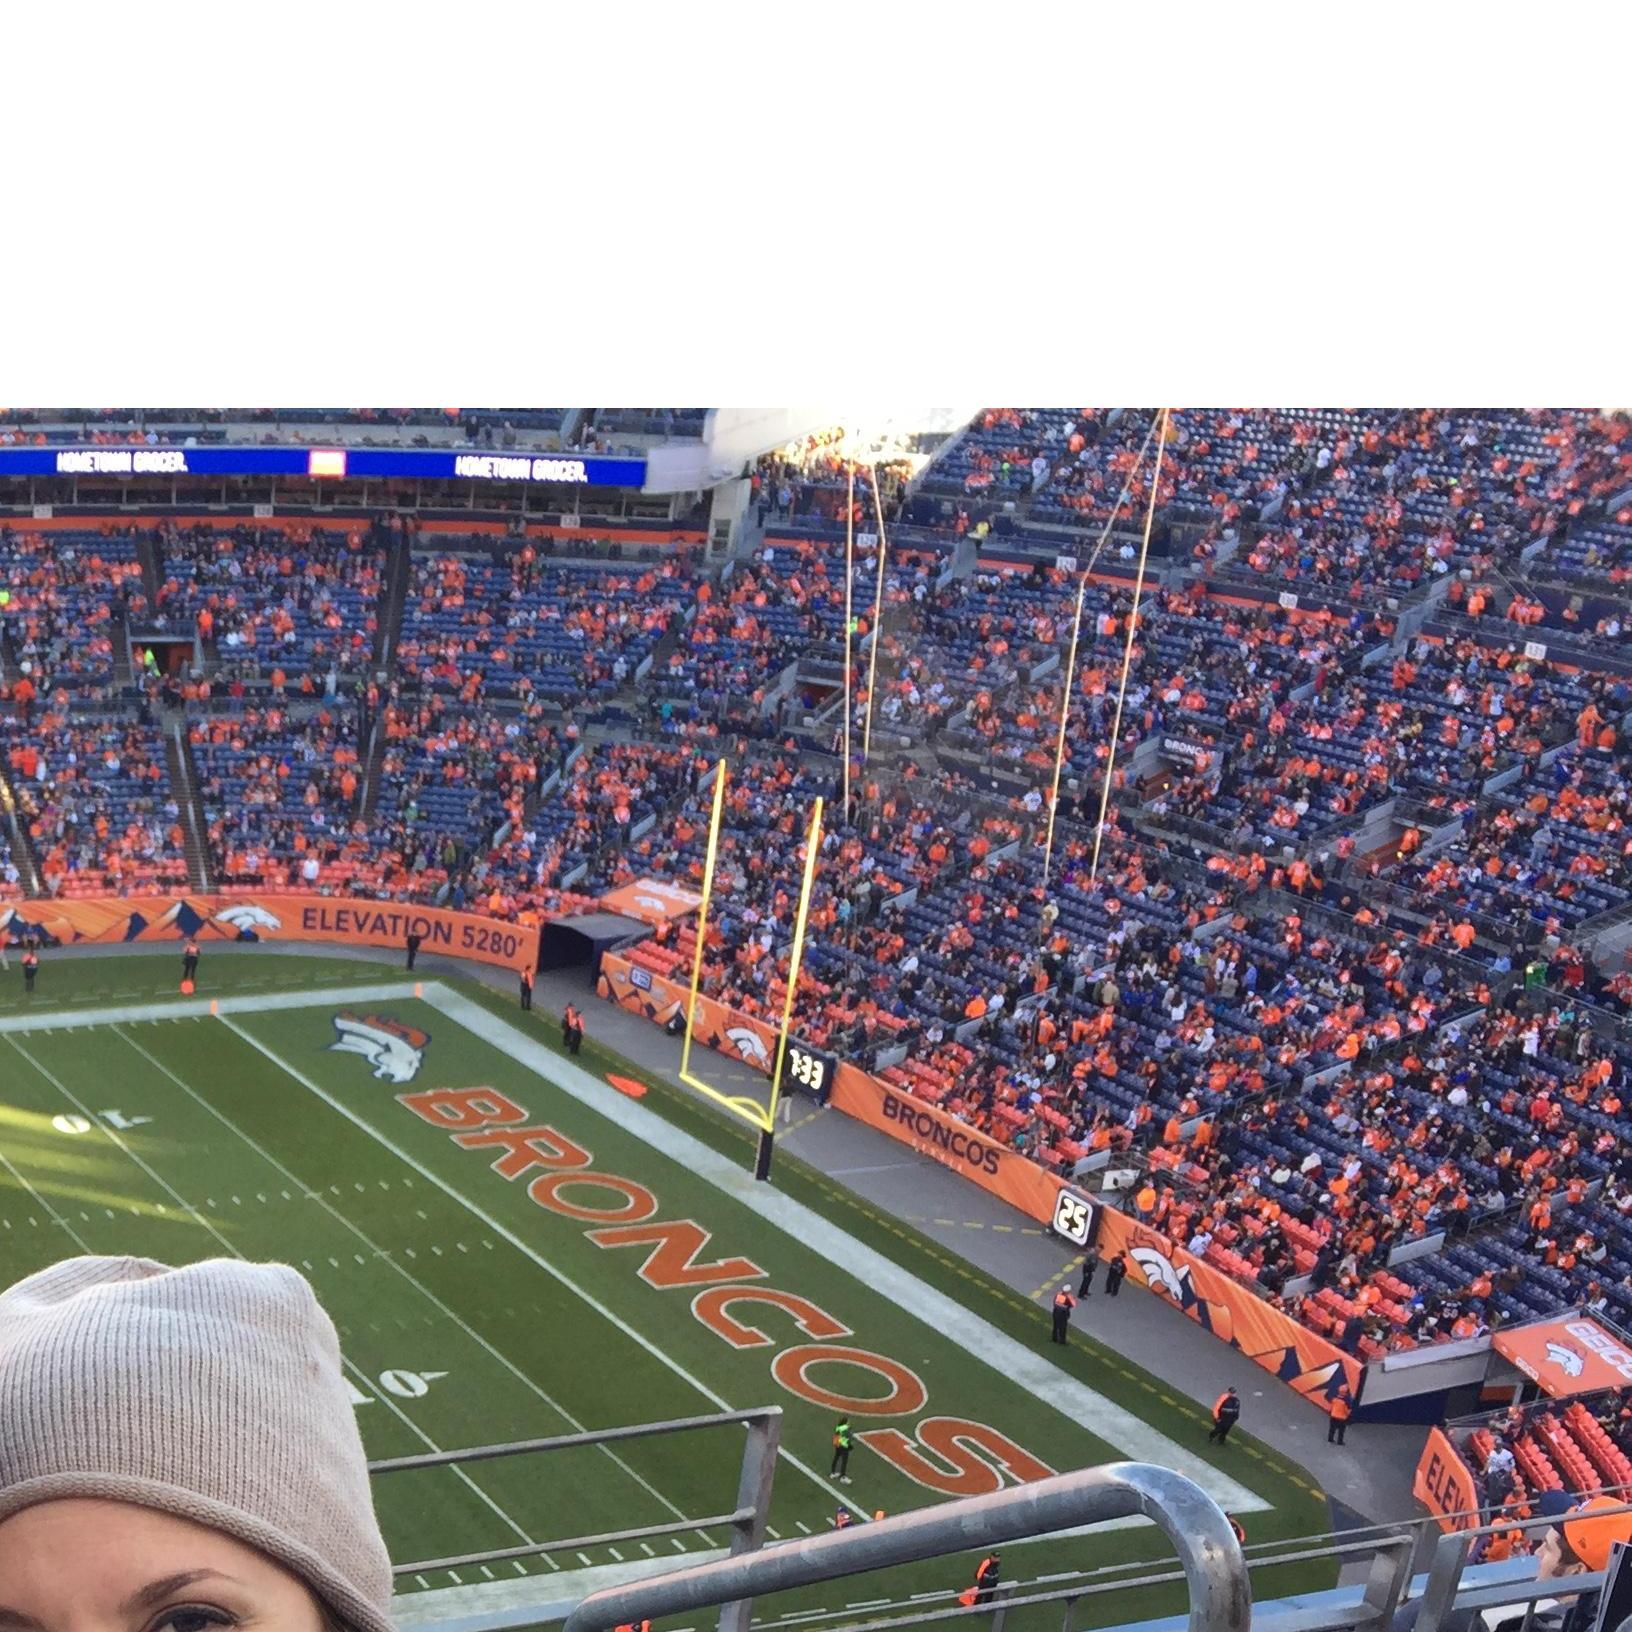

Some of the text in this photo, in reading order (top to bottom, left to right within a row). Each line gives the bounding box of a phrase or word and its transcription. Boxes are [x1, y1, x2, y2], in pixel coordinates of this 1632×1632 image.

[302, 907, 452, 945] ELEVATION
[883, 1095, 1001, 1175] BRONCOS
[1059, 1197, 1087, 1239] 25
[395, 1086, 1060, 1497] BRONCOS
